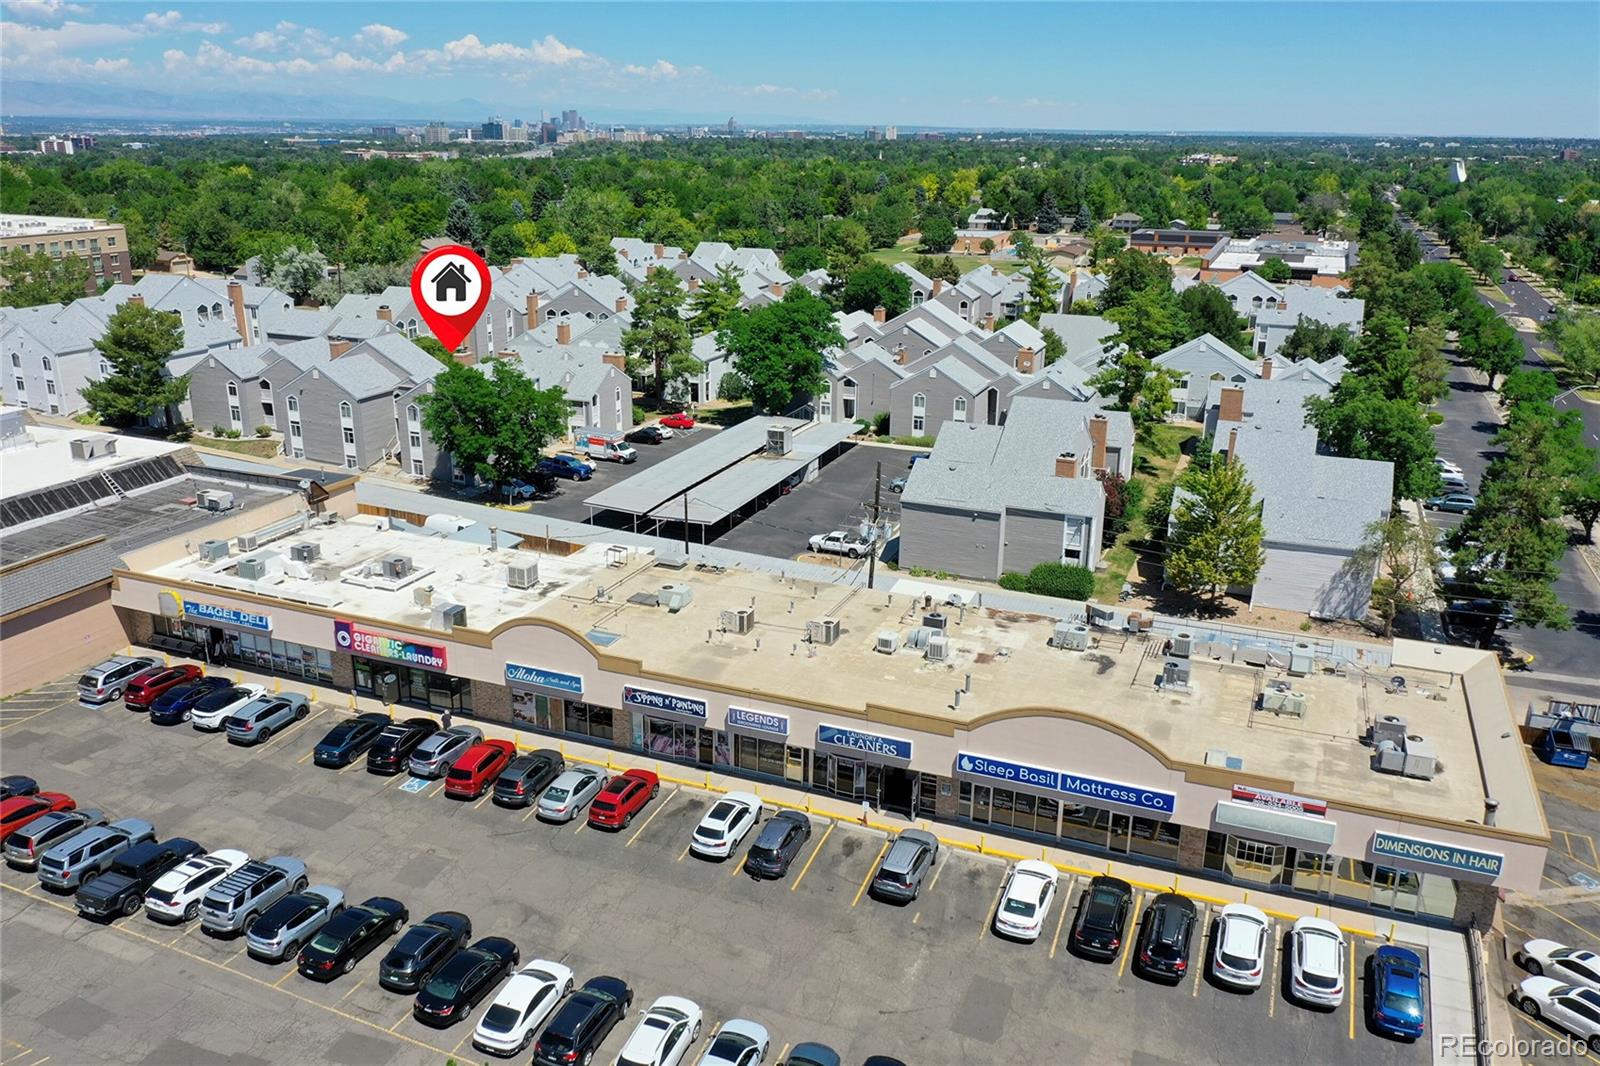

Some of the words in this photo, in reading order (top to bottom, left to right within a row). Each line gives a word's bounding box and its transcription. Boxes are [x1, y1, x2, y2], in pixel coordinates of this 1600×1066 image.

[199, 604, 238, 620] BAGEL
[240, 611, 267, 626] DELI
[353, 632, 403, 650] GIGATIC
[354, 642, 443, 667] CLEANRS-LAUNDRY
[507, 667, 545, 683] Aloha
[736, 711, 779, 727] LEGENDS
[833, 734, 897, 756] CLEANERS
[846, 730, 876, 742] LAUNDRY
[974, 759, 1015, 778] Sleep
[1019, 769, 1055, 787] Basil
[1066, 777, 1137, 802] Mattress
[1141, 792, 1168, 808] Co.
[1254, 793, 1303, 807] AVAILABLE
[1375, 837, 1450, 862] DIMENSIONS
[1452, 852, 1466, 865] IN
[1469, 855, 1499, 871] HAIR
